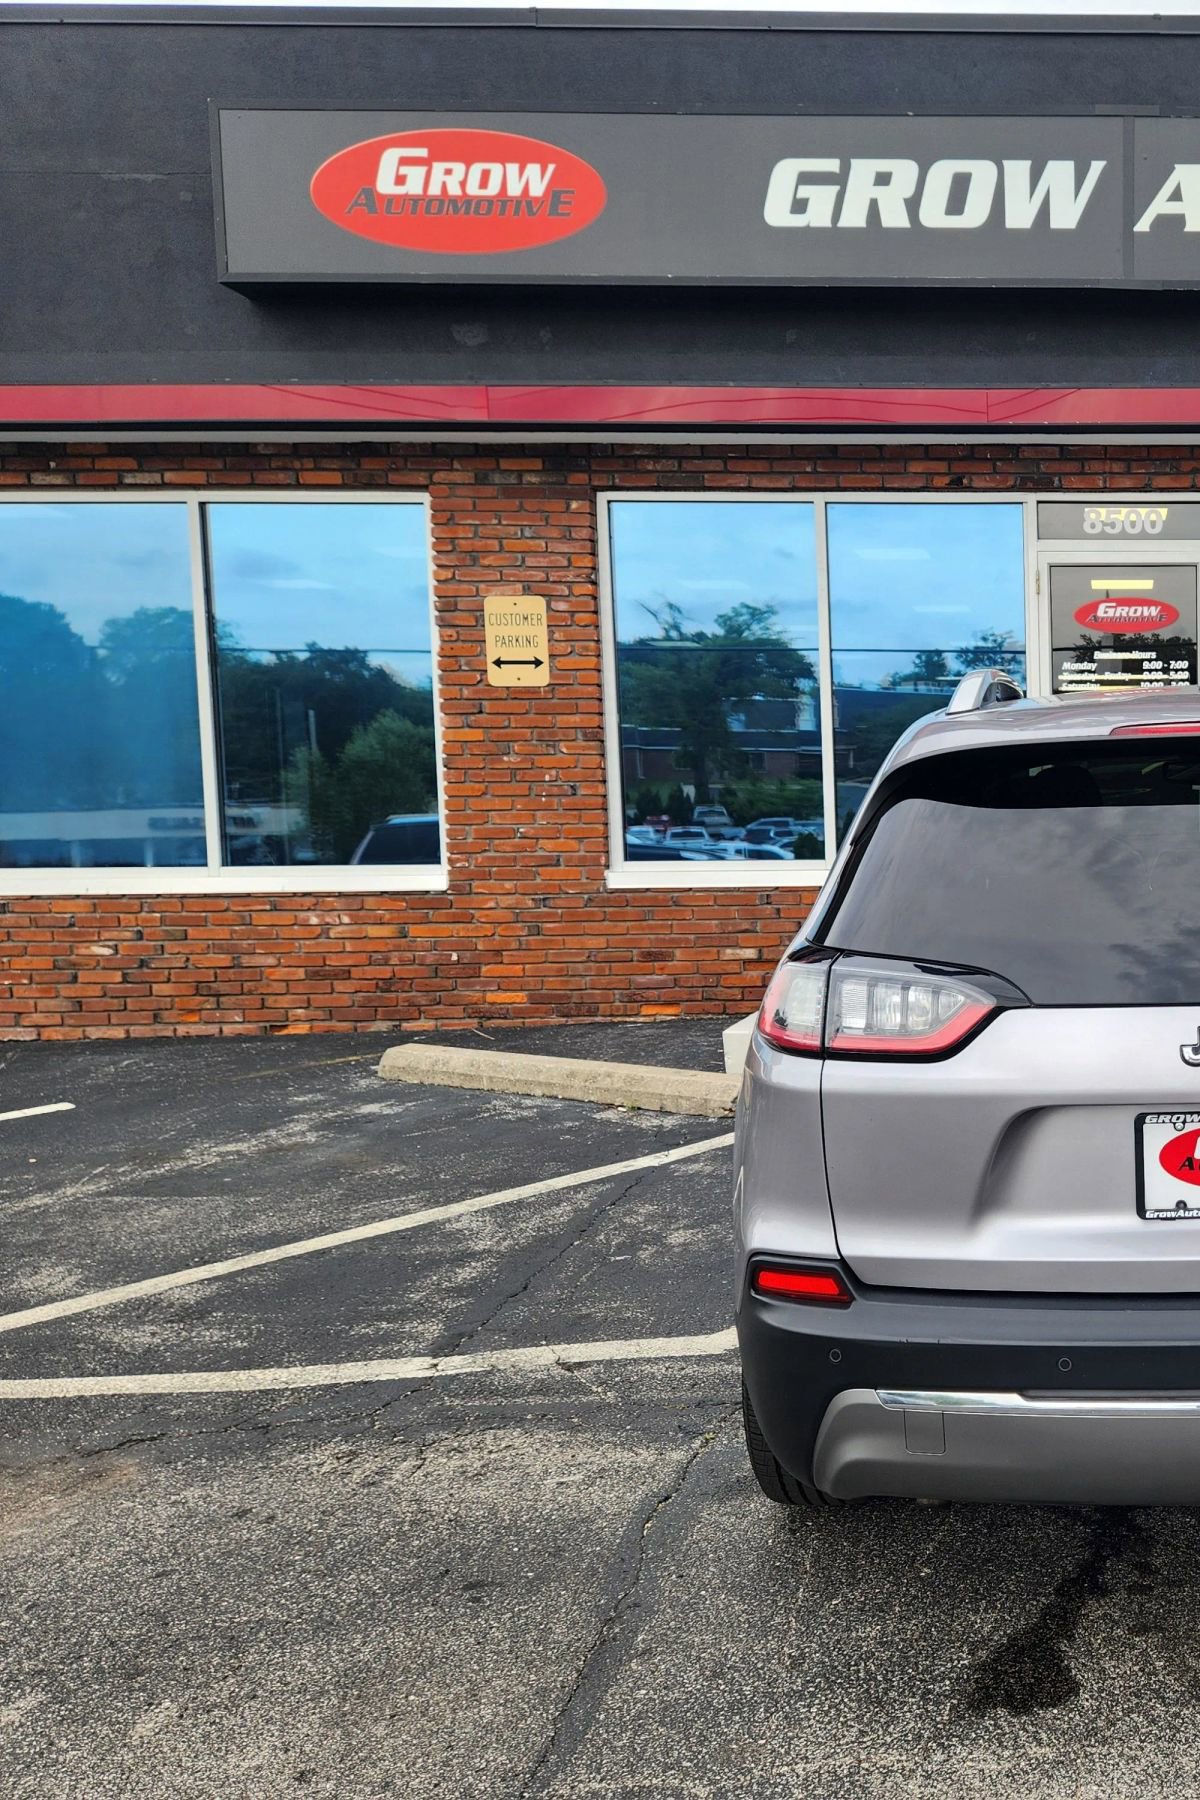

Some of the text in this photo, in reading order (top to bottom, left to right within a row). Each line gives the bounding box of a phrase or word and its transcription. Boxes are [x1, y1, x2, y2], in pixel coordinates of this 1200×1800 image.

[375, 147, 557, 198] GROW
[344, 186, 576, 218] AUTOMOTIVE
[763, 157, 1108, 229] GROW
[1082, 507, 1164, 535] 8500
[488, 612, 543, 627] CUSTOMER
[1096, 602, 1162, 618] GROW
[494, 634, 539, 648] PARKING
[1061, 661, 1098, 671] Monday
[1142, 660, 1163, 670] 9:00
[1169, 660, 1189, 670] 7:00
